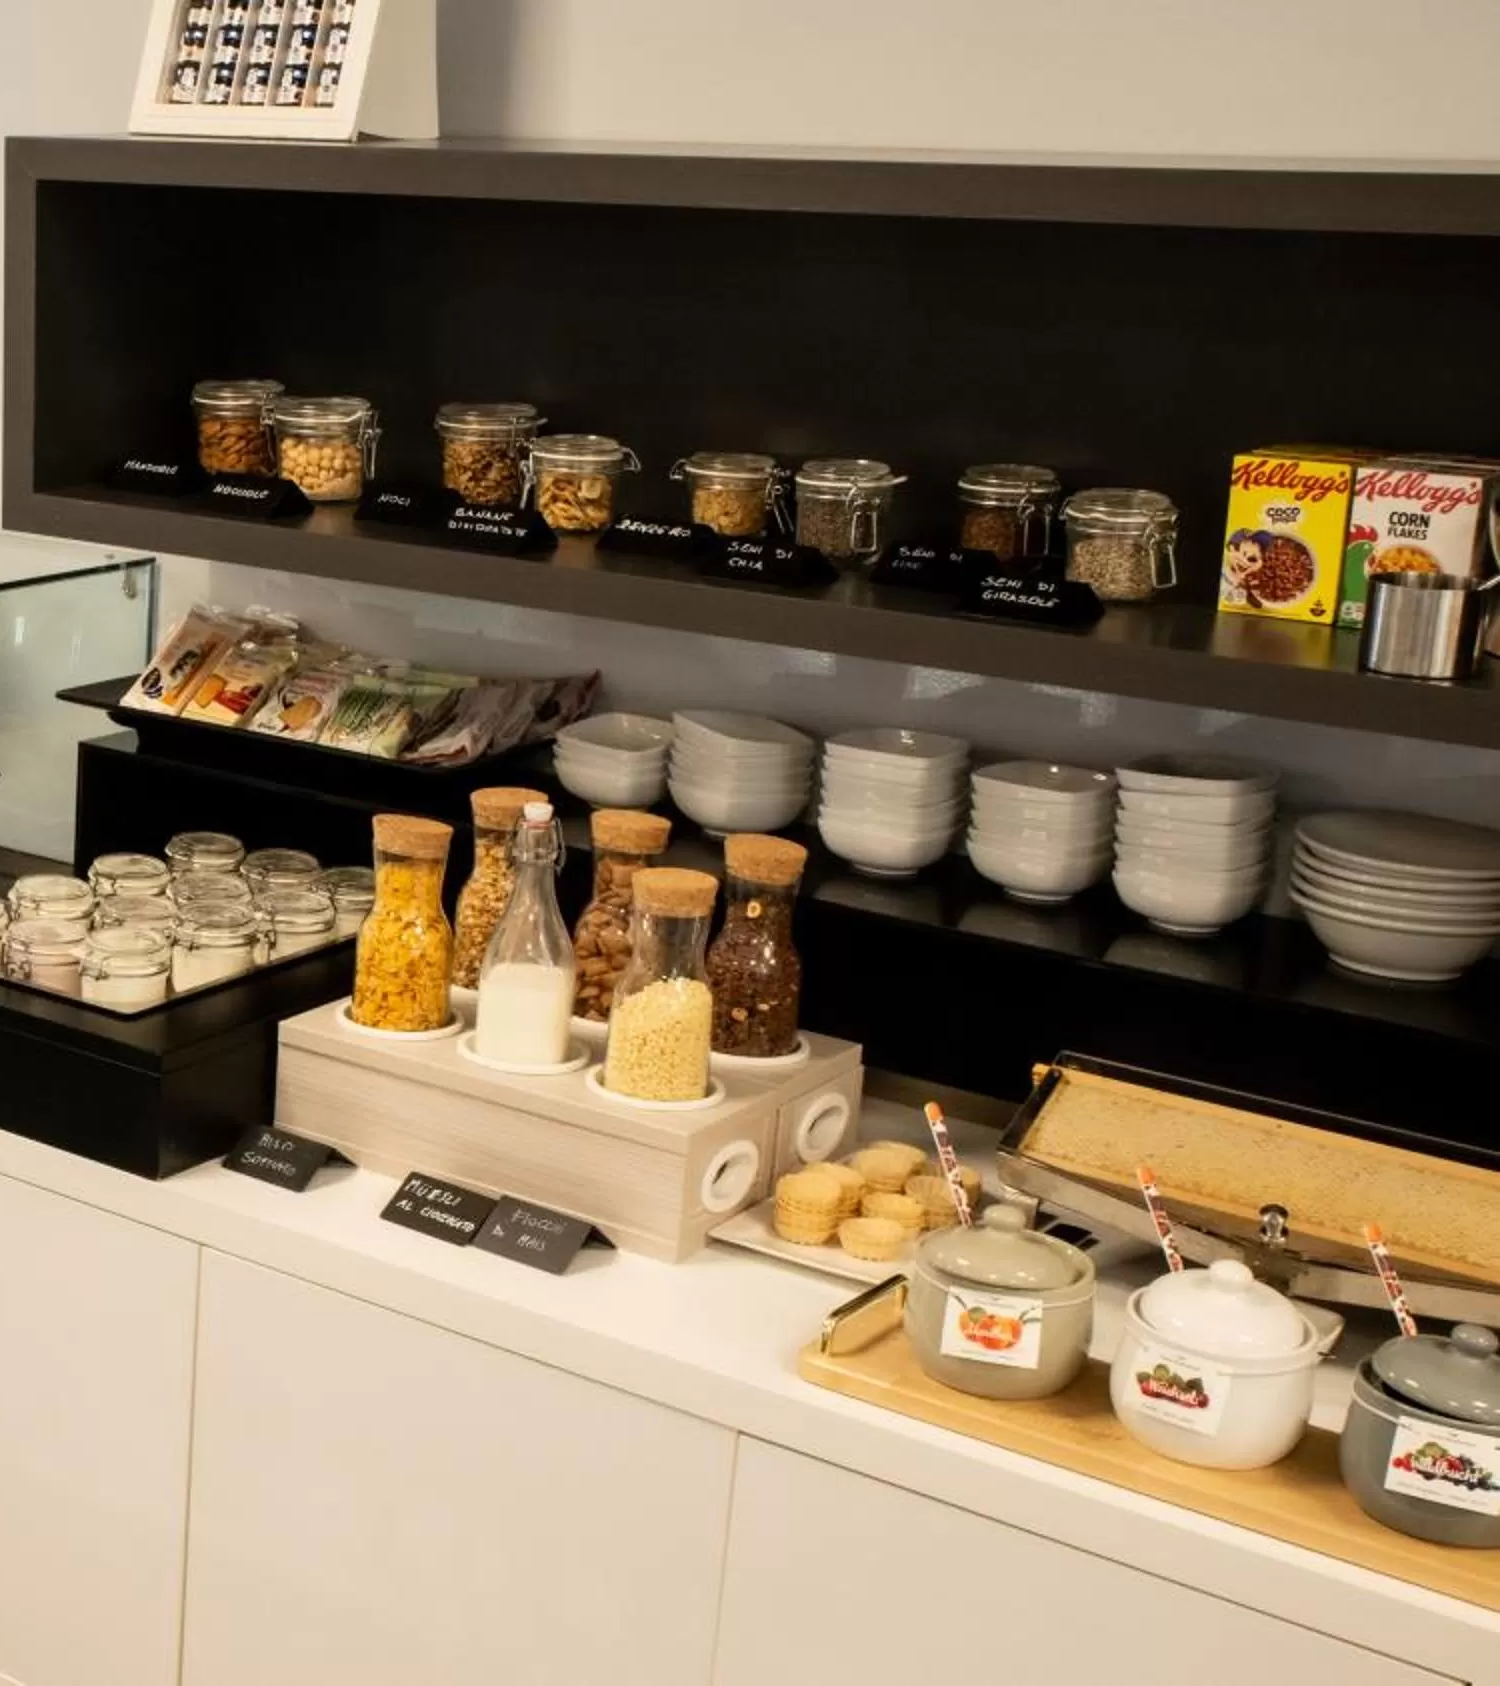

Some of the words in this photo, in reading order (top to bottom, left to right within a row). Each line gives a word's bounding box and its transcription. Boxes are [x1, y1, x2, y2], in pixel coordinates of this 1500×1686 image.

[1231, 460, 1350, 503] Kellogg's
[377, 493, 411, 507] NOCI
[1355, 470, 1482, 515] Kellogg's
[454, 507, 515, 522] BANANE
[1388, 511, 1431, 529] CORN
[1387, 526, 1428, 541] FLAKES
[727, 541, 764, 555] SEMI
[775, 548, 793, 560] DI
[728, 557, 764, 571] CHIA
[980, 575, 1023, 589] SEMI
[1037, 581, 1055, 593] DI
[982, 590, 1060, 609] GIRASOLE
